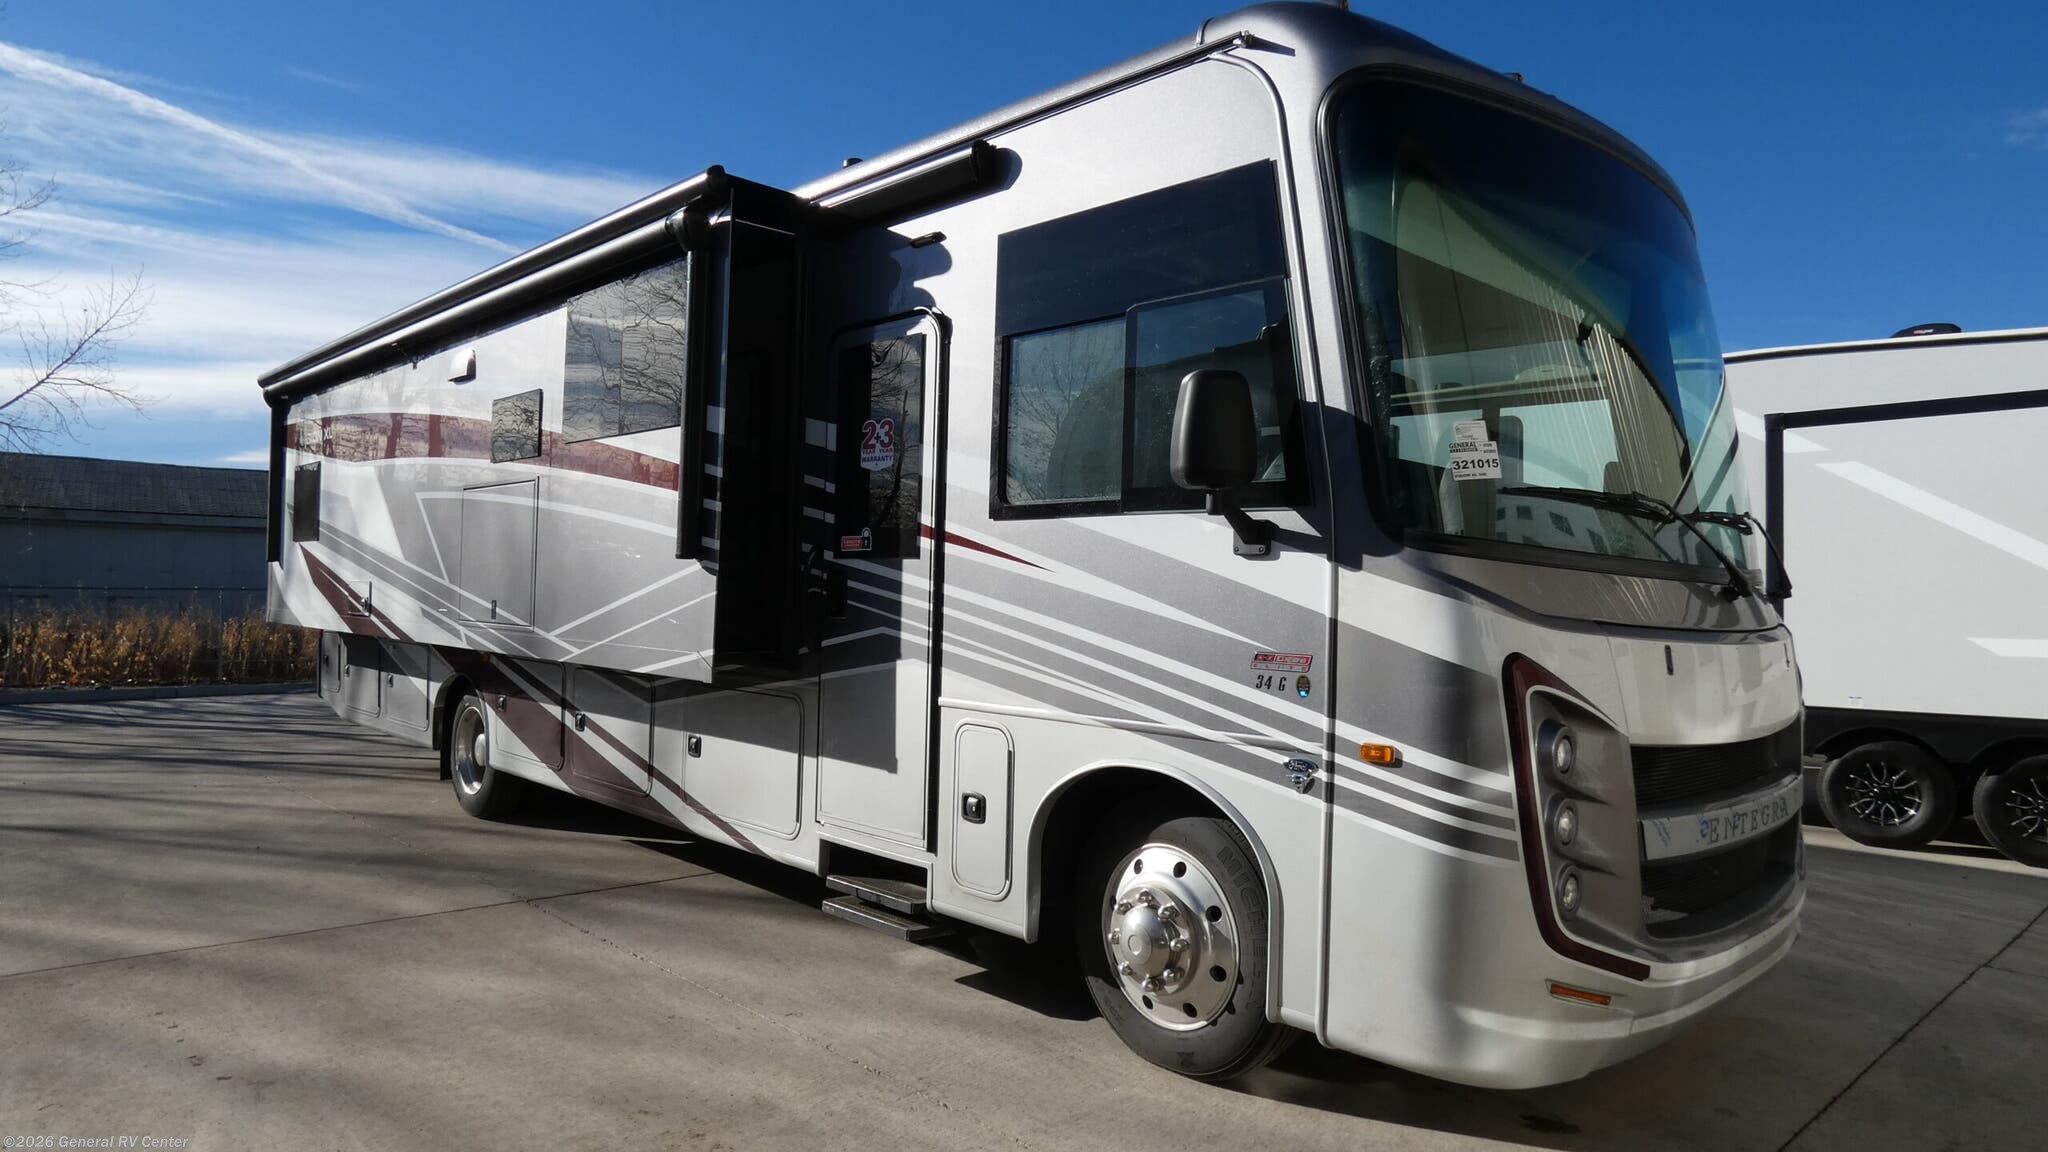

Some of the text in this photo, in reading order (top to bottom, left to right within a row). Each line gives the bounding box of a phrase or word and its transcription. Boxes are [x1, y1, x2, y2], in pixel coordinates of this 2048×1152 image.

[1448, 441, 1478, 449] GENERAL
[862, 455, 893, 463] WARRANTY
[1452, 458, 1500, 471] 321015
[1255, 674, 1273, 690] 34
[1278, 676, 1287, 692] G
[1707, 797, 1790, 846] ENTEGRA
